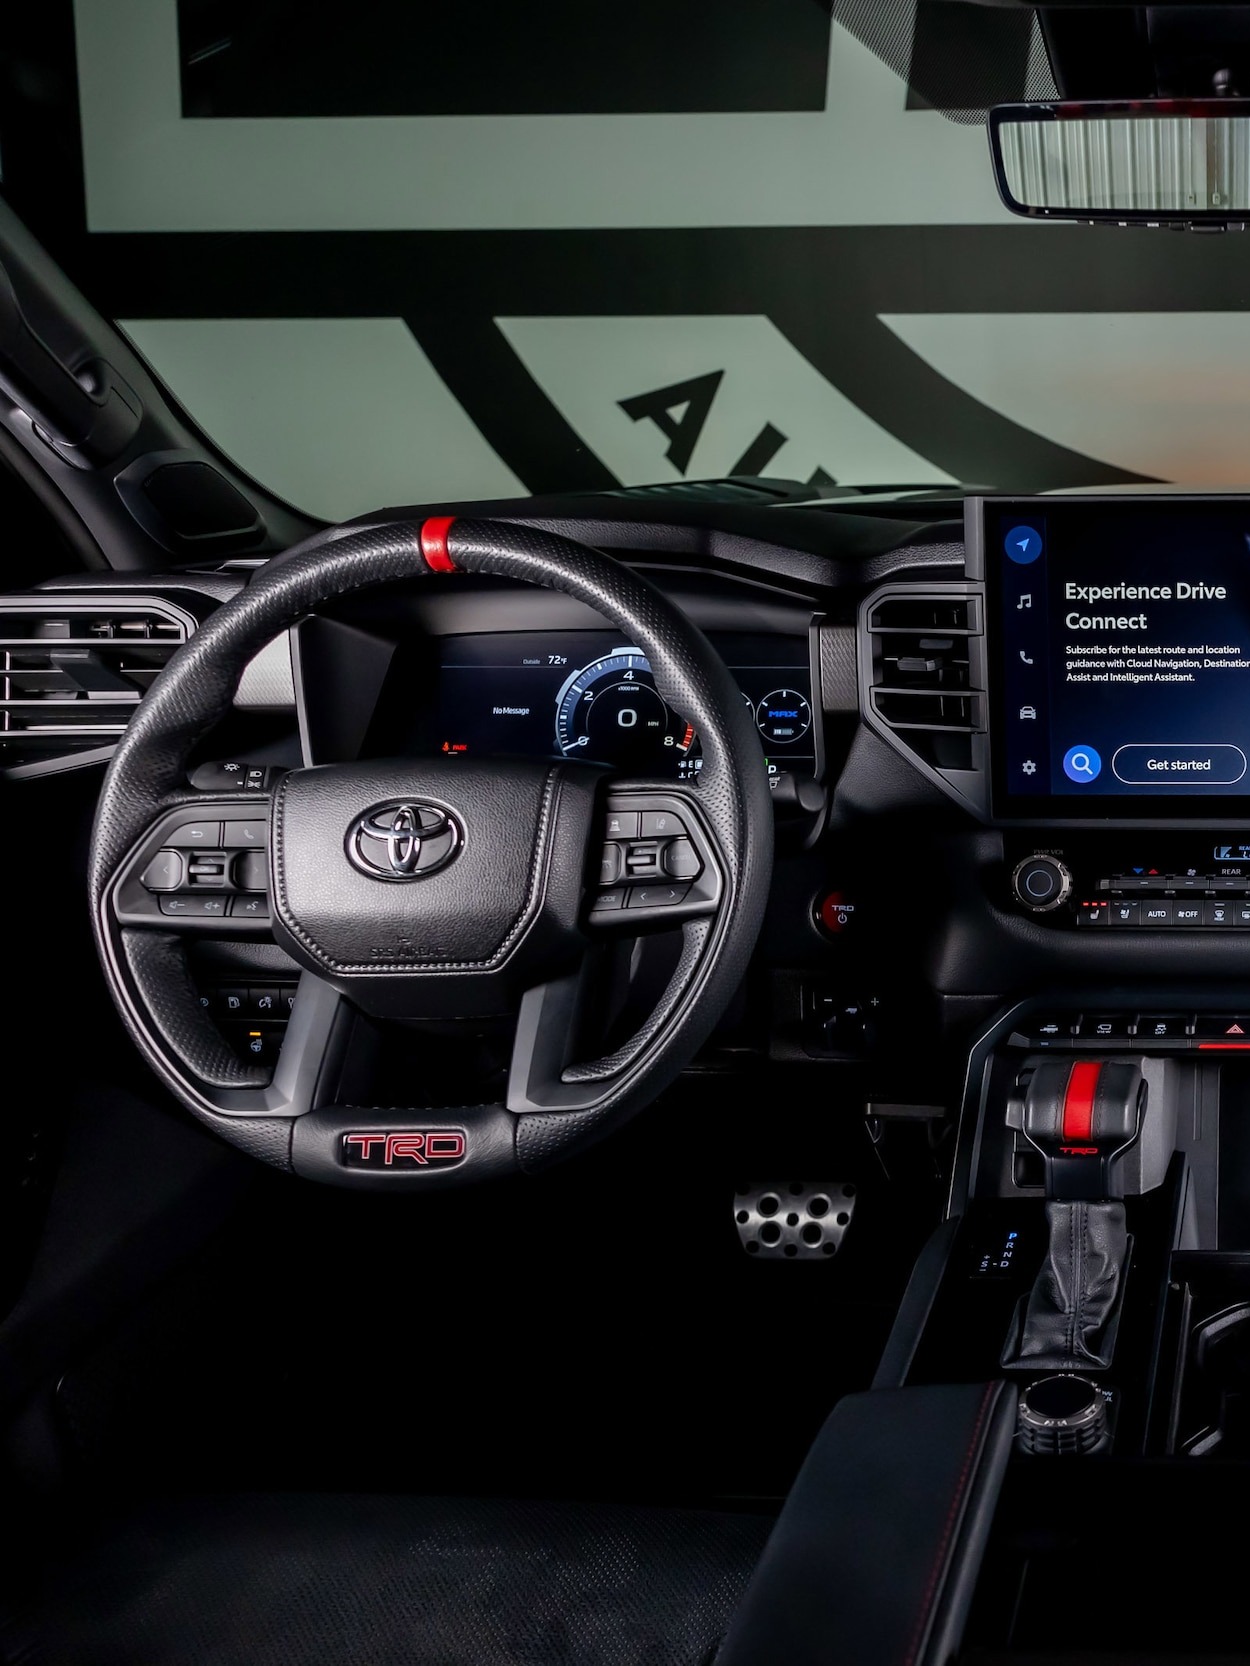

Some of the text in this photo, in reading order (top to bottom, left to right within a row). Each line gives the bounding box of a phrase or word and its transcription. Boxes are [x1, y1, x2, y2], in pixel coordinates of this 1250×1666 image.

[1065, 582, 1227, 603] Experience Drive
[1065, 612, 1148, 630] Connect
[1066, 645, 1241, 654] Subscribe for the latest route and location
[1066, 659, 1106, 669] guidance
[1106, 659, 1126, 668] with
[1126, 659, 1153, 668] Cloud
[1153, 659, 1203, 669] Navigation,
[623, 670, 634, 680] 4
[1066, 673, 1196, 683] Assist and Intelligent Assistant.
[584, 691, 594, 701] 2
[502, 707, 530, 716] Message
[618, 709, 637, 727] 0
[663, 736, 674, 746] 8
[768, 765, 777, 774] P
[1147, 759, 1211, 770] Get started
[1147, 910, 1167, 918] AUTO
[1185, 910, 1198, 918] OFF
[346, 1133, 466, 1165] TRD
[1059, 1147, 1099, 1155] TRD
[1008, 1232, 1018, 1240] P
[1005, 1241, 1014, 1249] R
